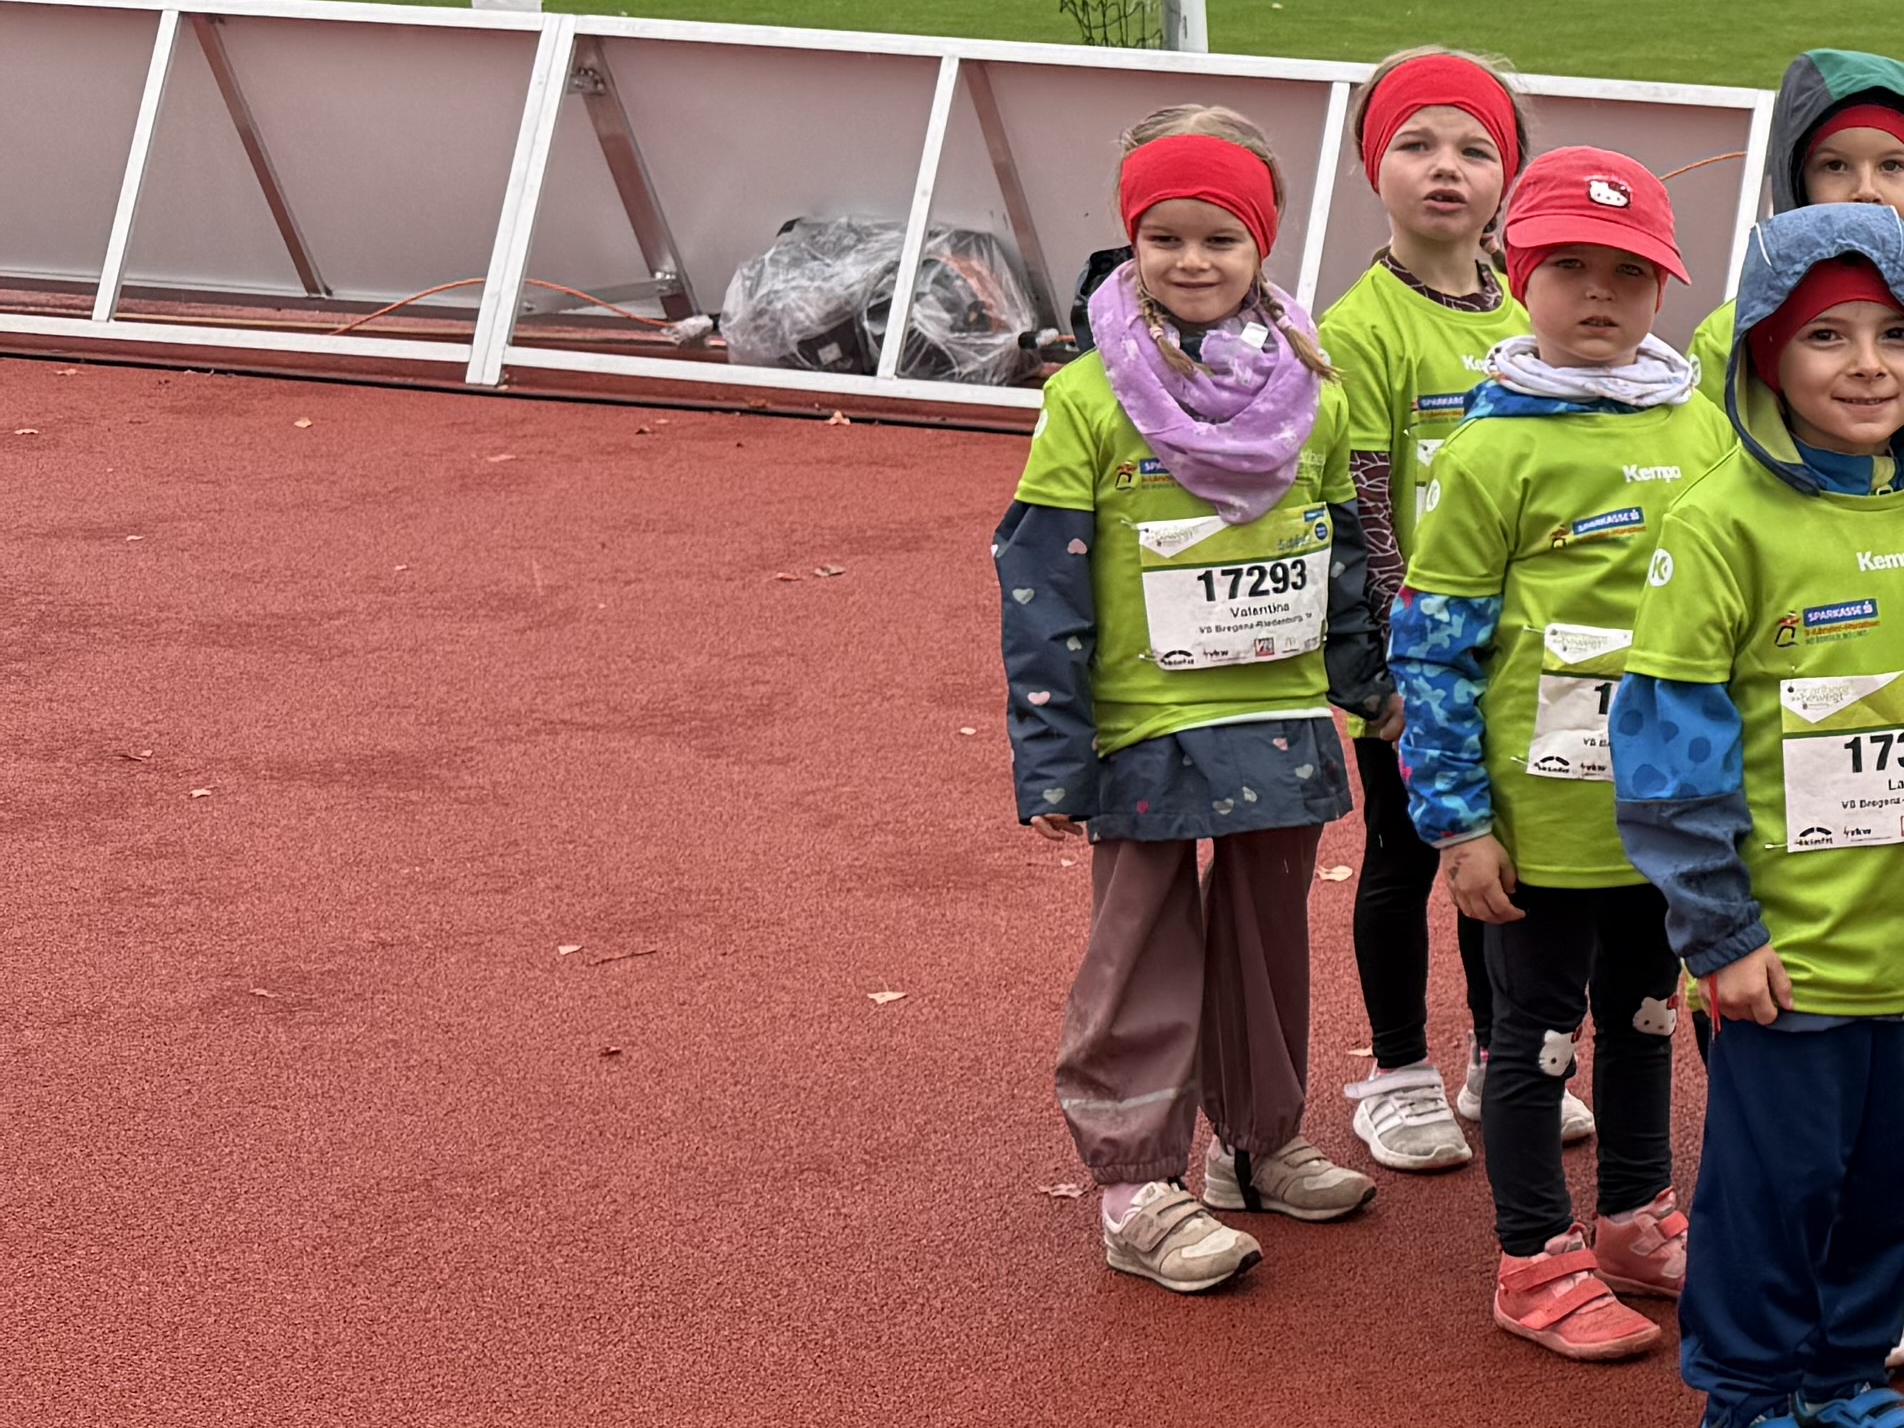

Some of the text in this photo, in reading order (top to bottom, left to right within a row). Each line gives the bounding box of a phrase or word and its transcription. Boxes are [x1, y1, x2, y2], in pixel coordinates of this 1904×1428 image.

[1622, 464, 1682, 483] Kempa
[1197, 559, 1308, 602] 17293
[1230, 602, 1290, 619] Valentina
[1807, 606, 1862, 623] SPARKASSE
